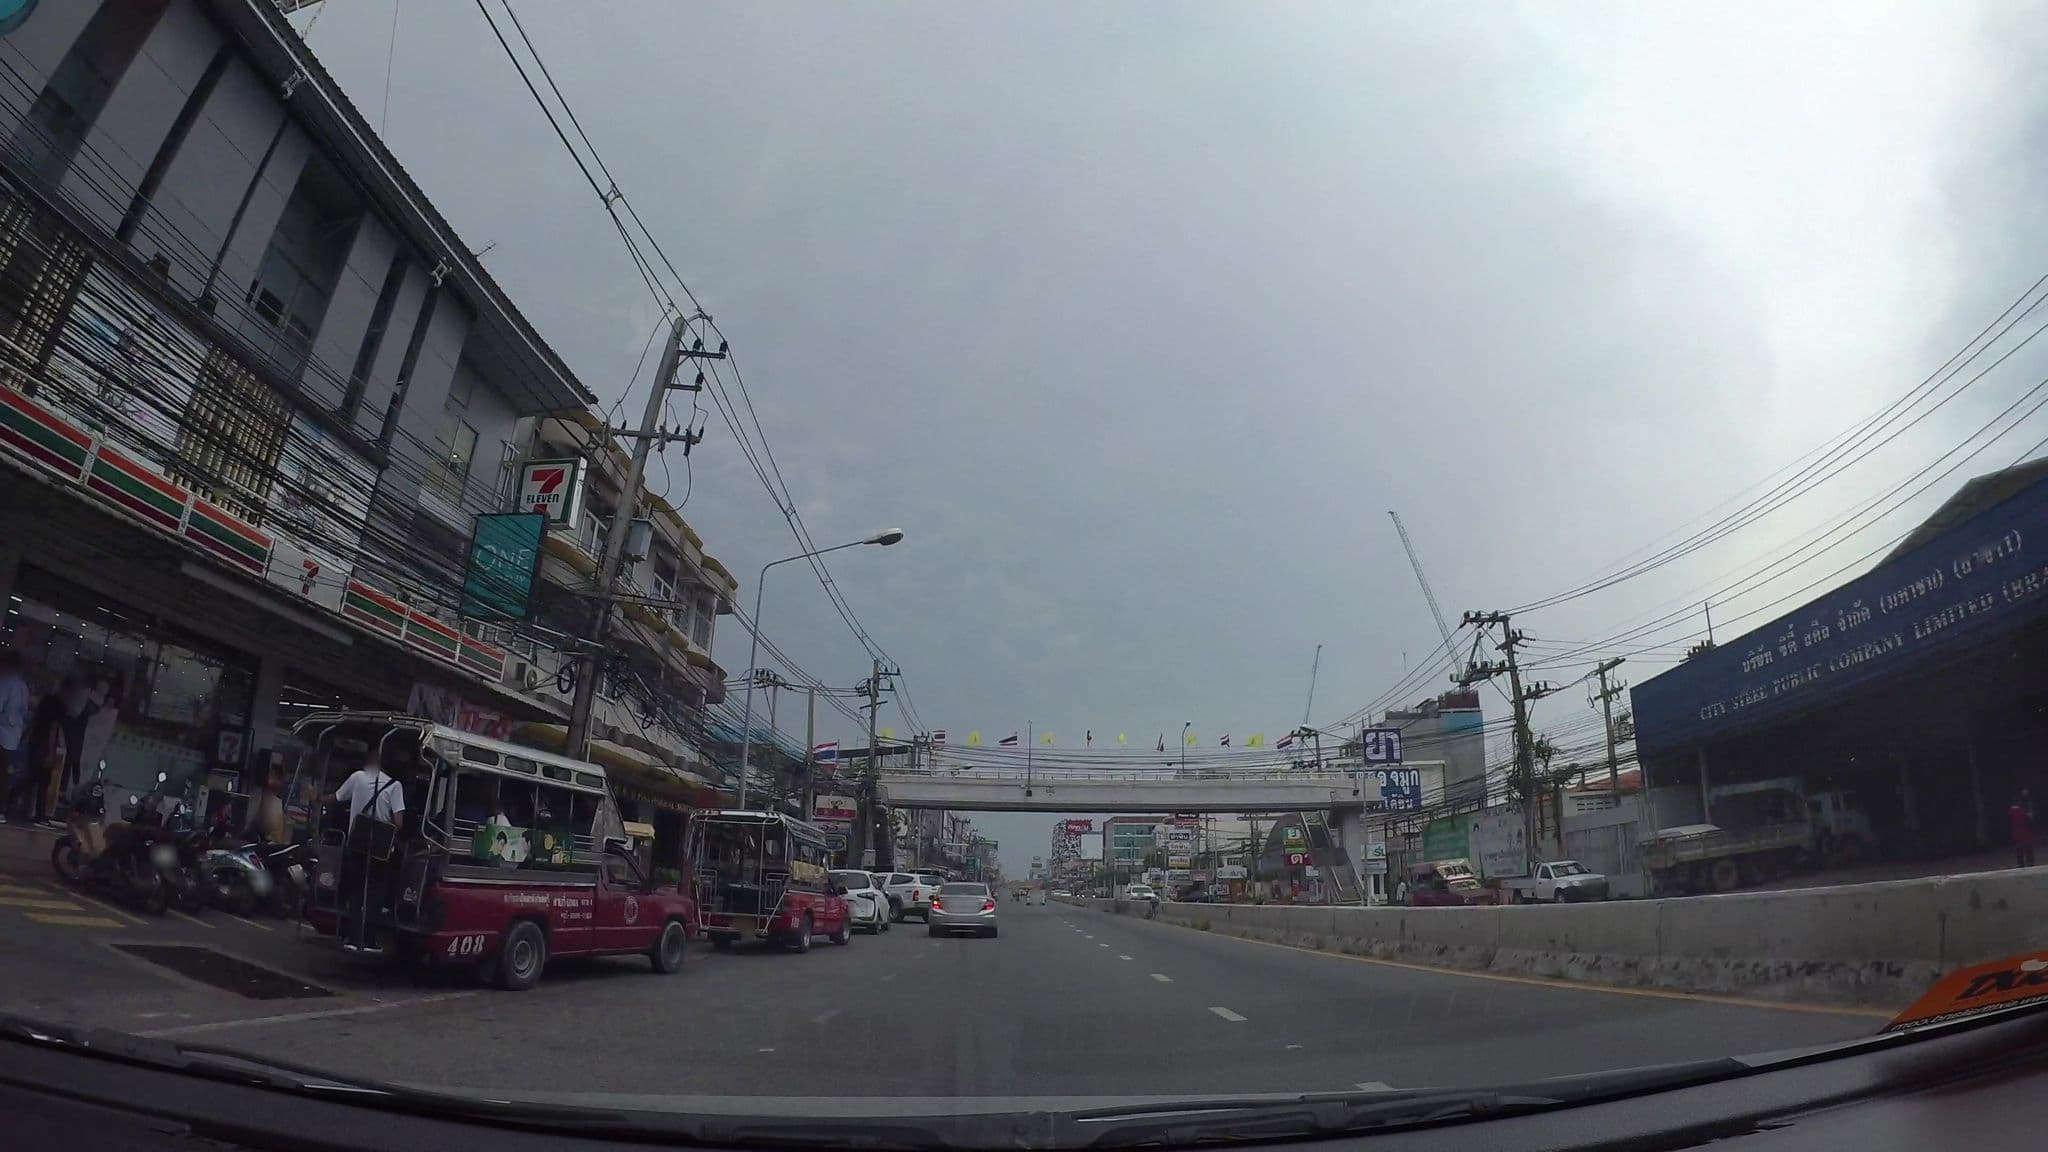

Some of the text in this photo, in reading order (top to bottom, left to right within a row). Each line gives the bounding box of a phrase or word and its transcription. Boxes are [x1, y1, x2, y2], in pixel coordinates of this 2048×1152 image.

[531, 469, 565, 514] 7
[1772, 662, 1824, 695] PUBLIC
[1829, 631, 1905, 672] COMPANY
[1913, 592, 1994, 640] LIMITED
[1365, 731, 1401, 760] ยา
[1390, 770, 1419, 795] จมูก
[447, 934, 487, 957] 408
